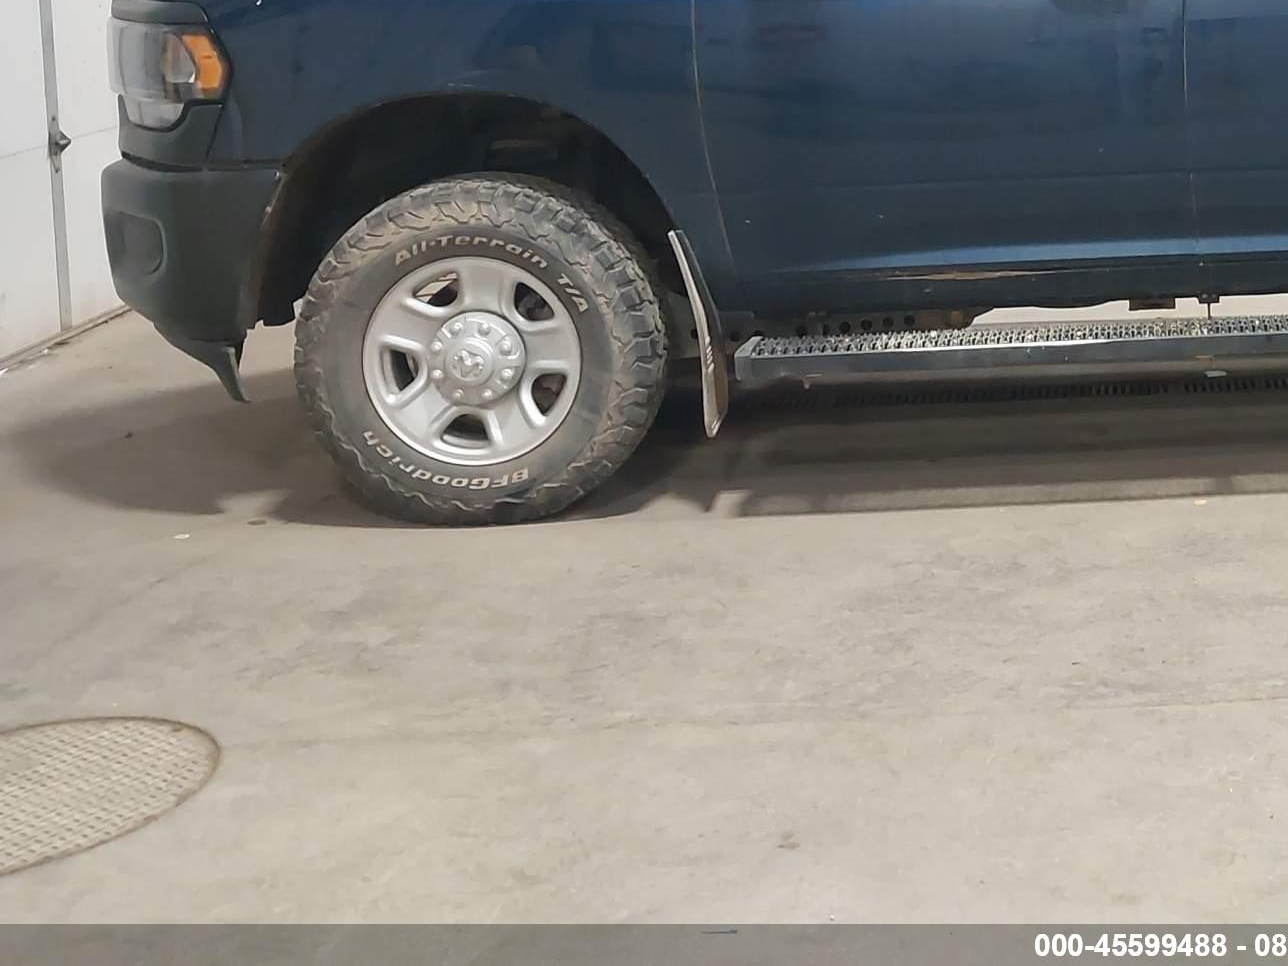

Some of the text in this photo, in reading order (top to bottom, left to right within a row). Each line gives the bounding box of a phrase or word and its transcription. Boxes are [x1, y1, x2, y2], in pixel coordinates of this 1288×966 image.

[394, 234, 589, 314] All-Terrain T/A
[363, 430, 530, 491] BFGoodrich
